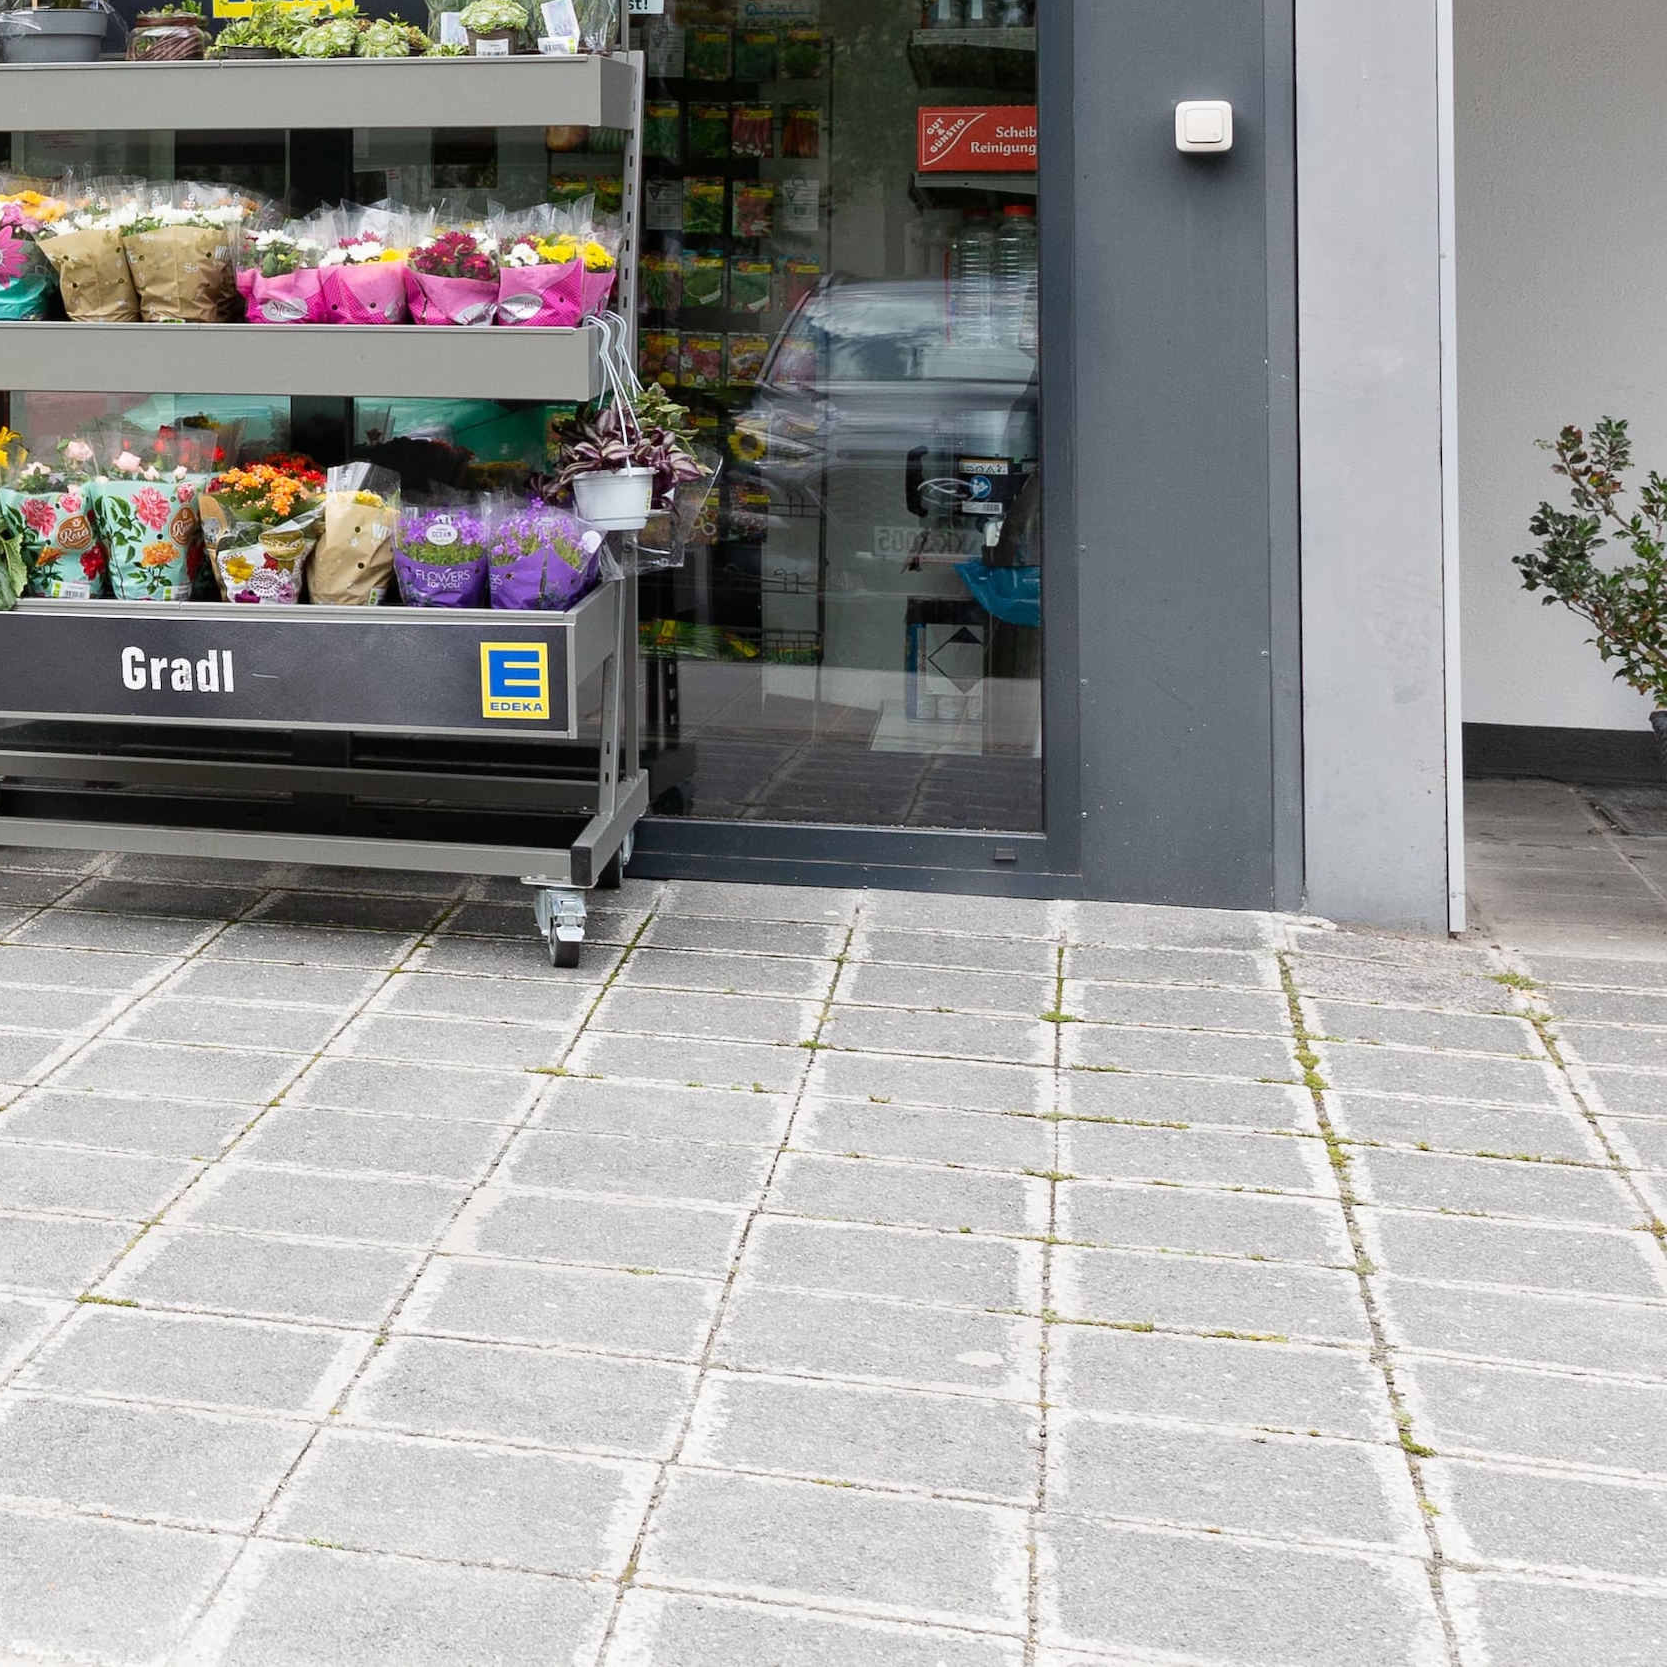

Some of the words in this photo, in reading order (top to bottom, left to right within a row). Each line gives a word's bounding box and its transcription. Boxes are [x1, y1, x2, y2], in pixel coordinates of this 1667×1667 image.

[927, 117, 944, 135] GUT
[995, 126, 1037, 138] Scheib
[930, 118, 965, 153] GÜNSTIG
[970, 141, 1037, 157] Reinigung
[415, 567, 471, 582] FLOWERS
[427, 578, 440, 589] for
[121, 645, 234, 694] Gradl
[489, 701, 544, 713] EDEKA
